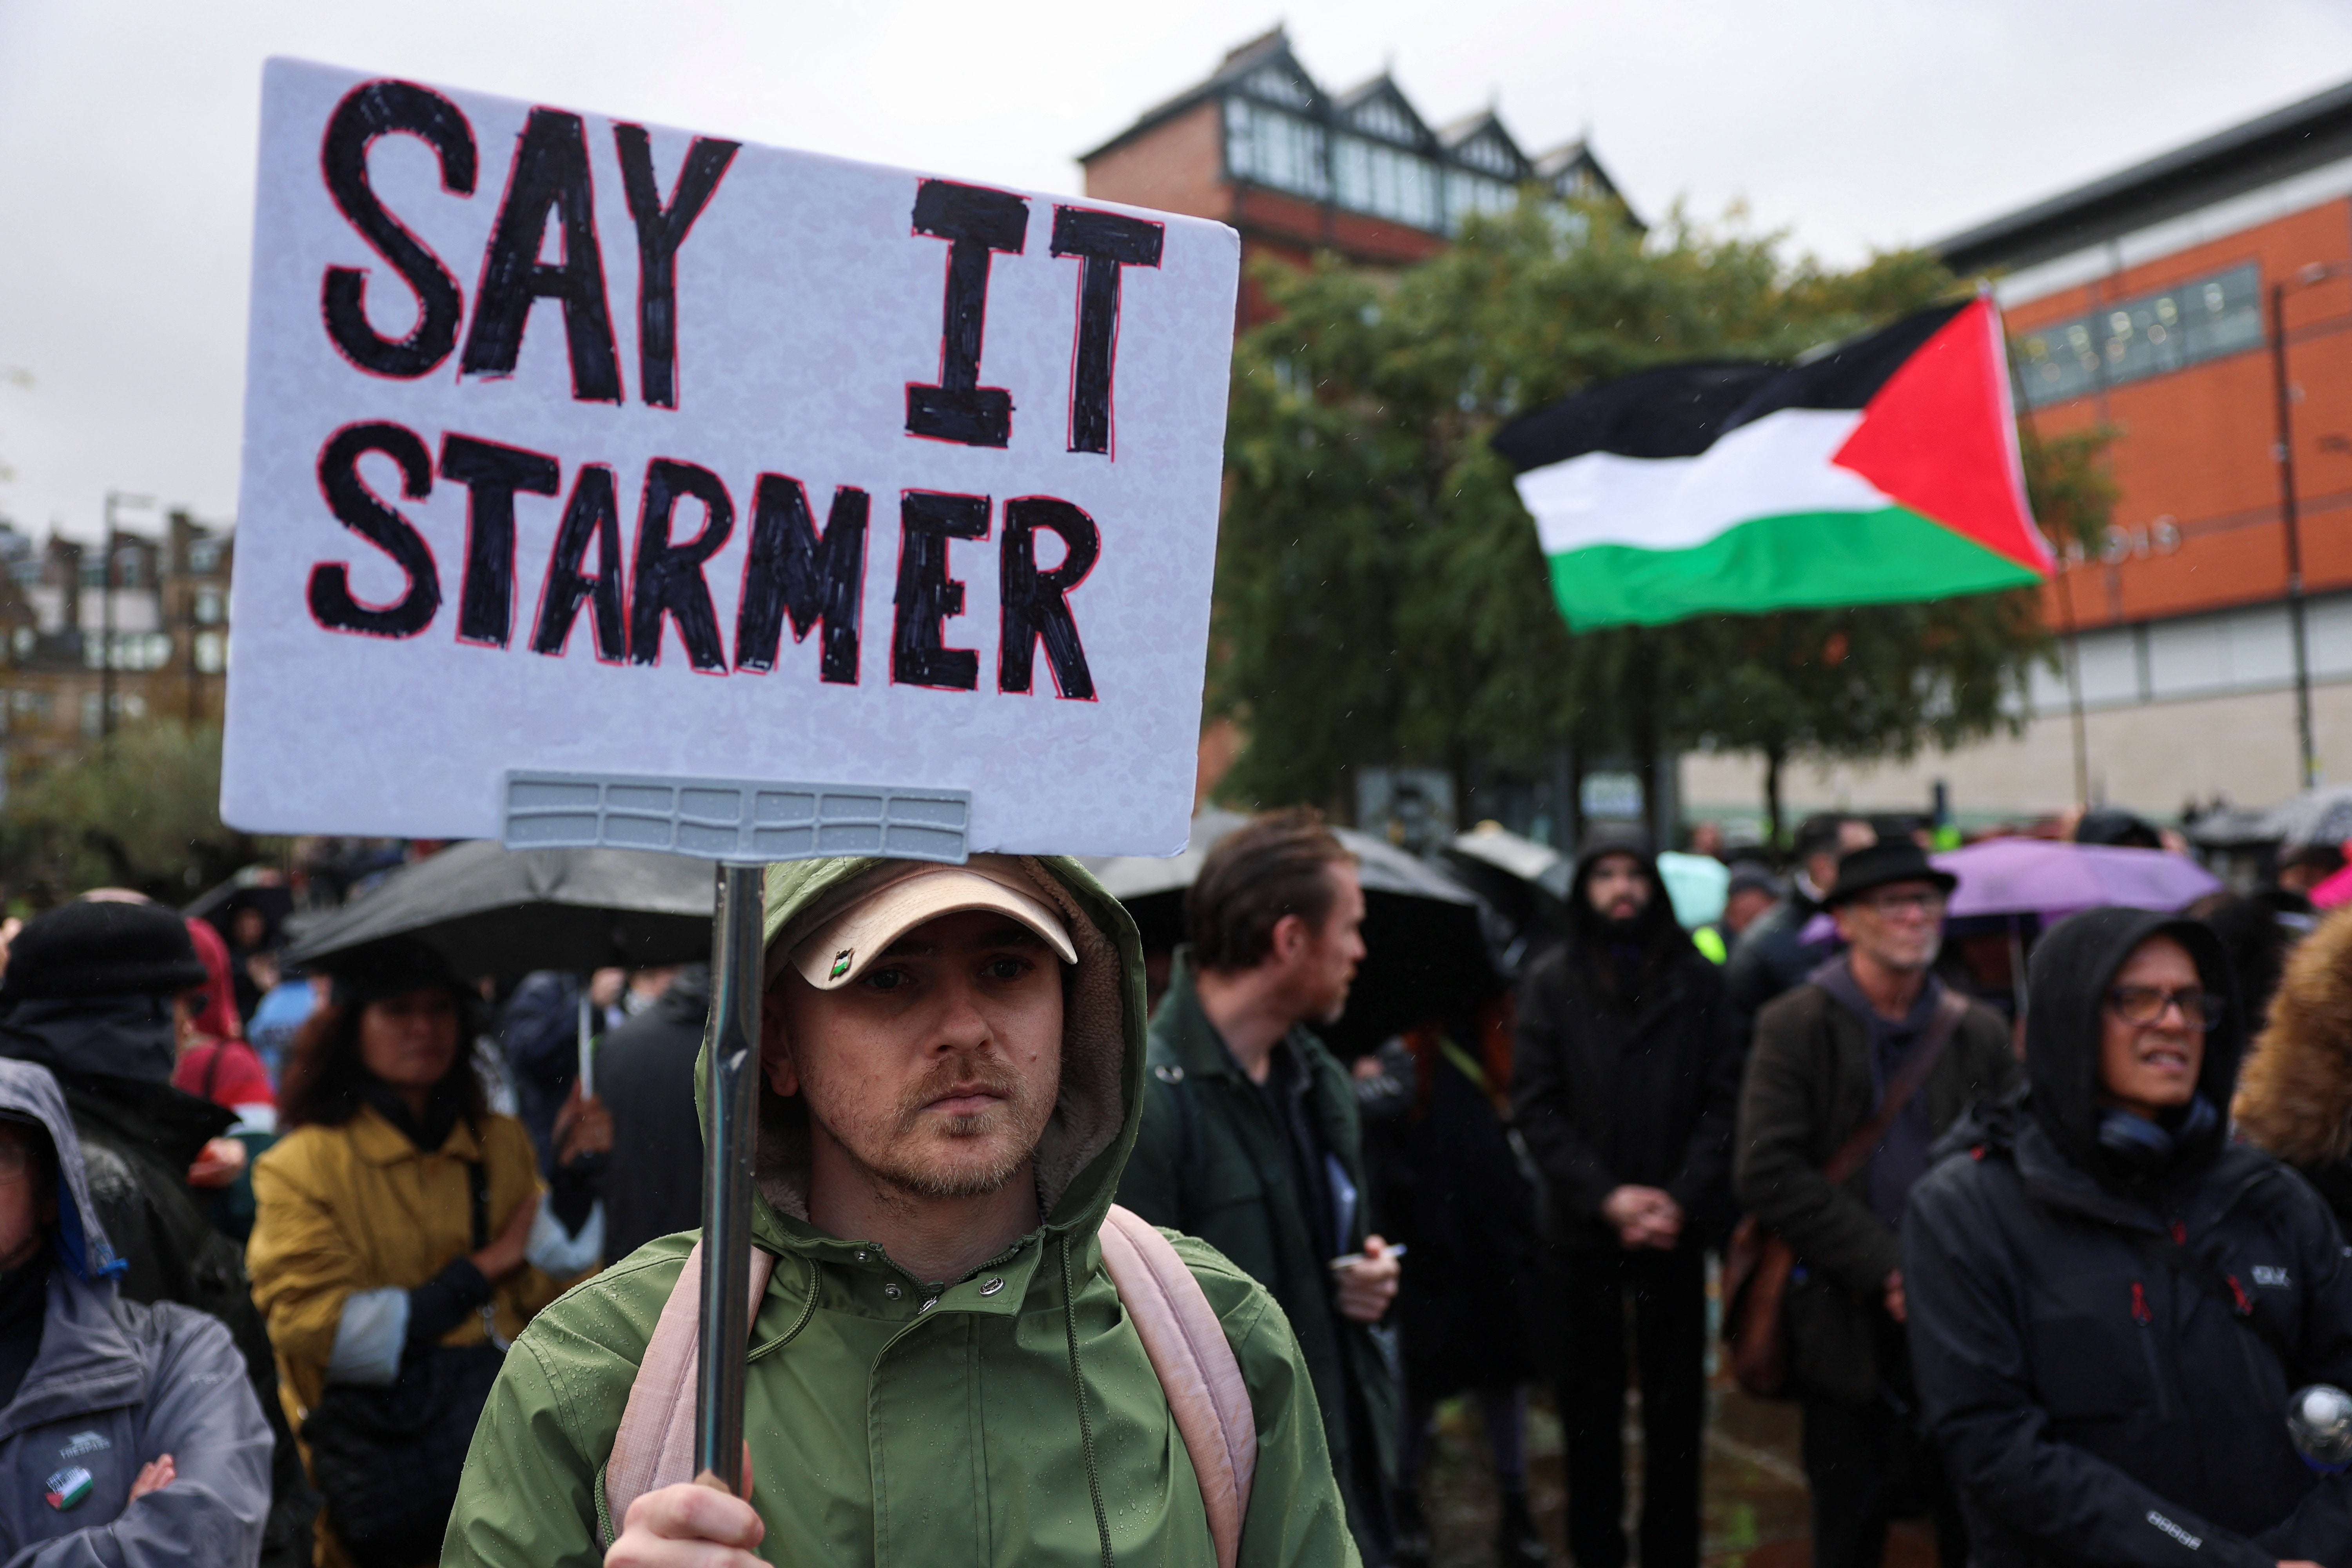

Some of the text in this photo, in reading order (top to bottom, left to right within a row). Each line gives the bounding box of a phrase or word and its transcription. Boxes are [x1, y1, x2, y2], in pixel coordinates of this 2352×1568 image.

[317, 80, 1166, 464] SAY IT
[303, 417, 1103, 703] STARMER
[59, 1437, 111, 1459] TRESPASS
